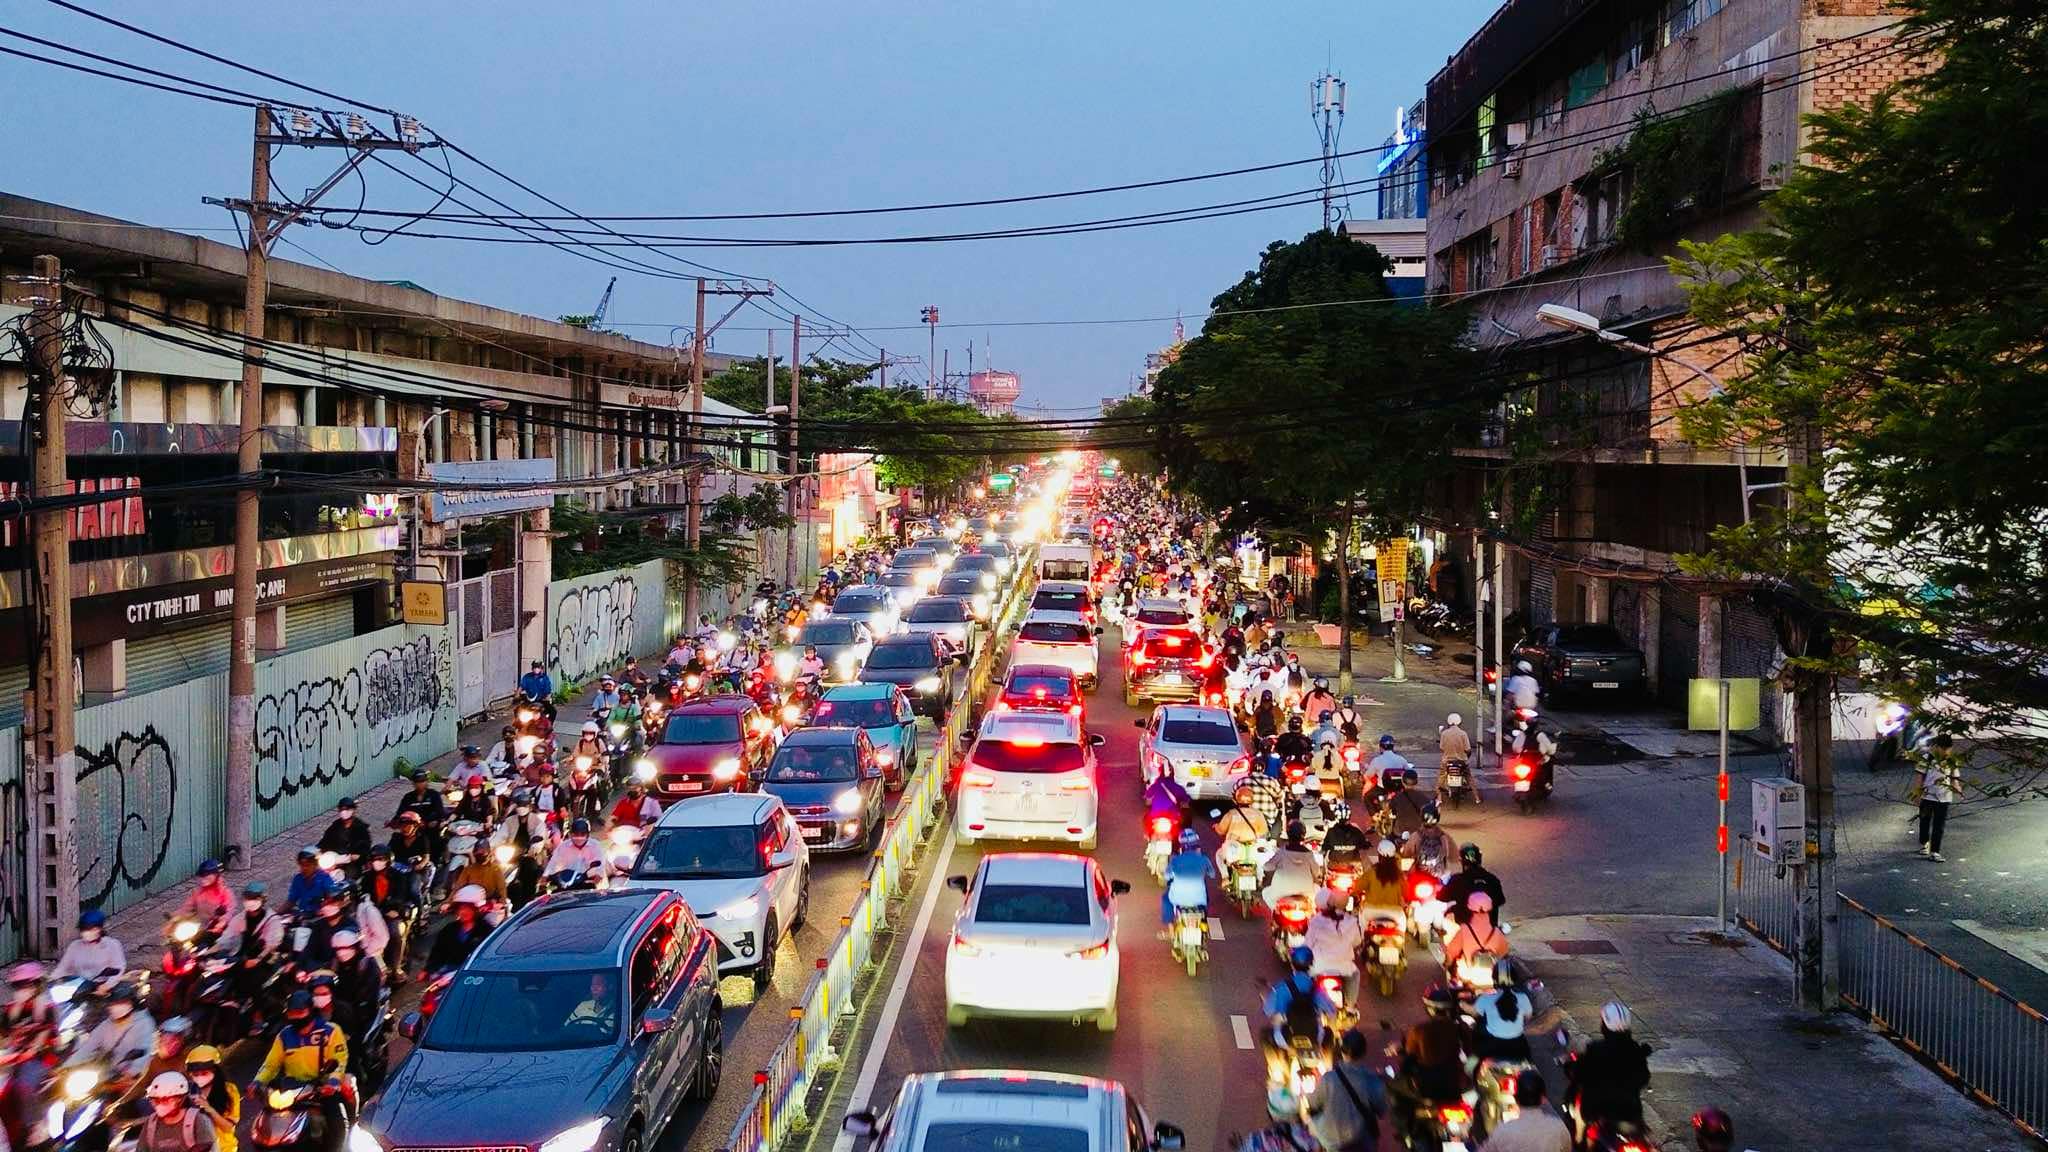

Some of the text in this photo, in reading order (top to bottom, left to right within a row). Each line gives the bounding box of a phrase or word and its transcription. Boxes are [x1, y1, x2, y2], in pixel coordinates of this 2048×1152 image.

[126, 602, 151, 624] CTY
[153, 597, 183, 618] TNHH
[184, 594, 200, 613] TM
[267, 579, 286, 598] ANH
[409, 608, 439, 617] YAMAHA
